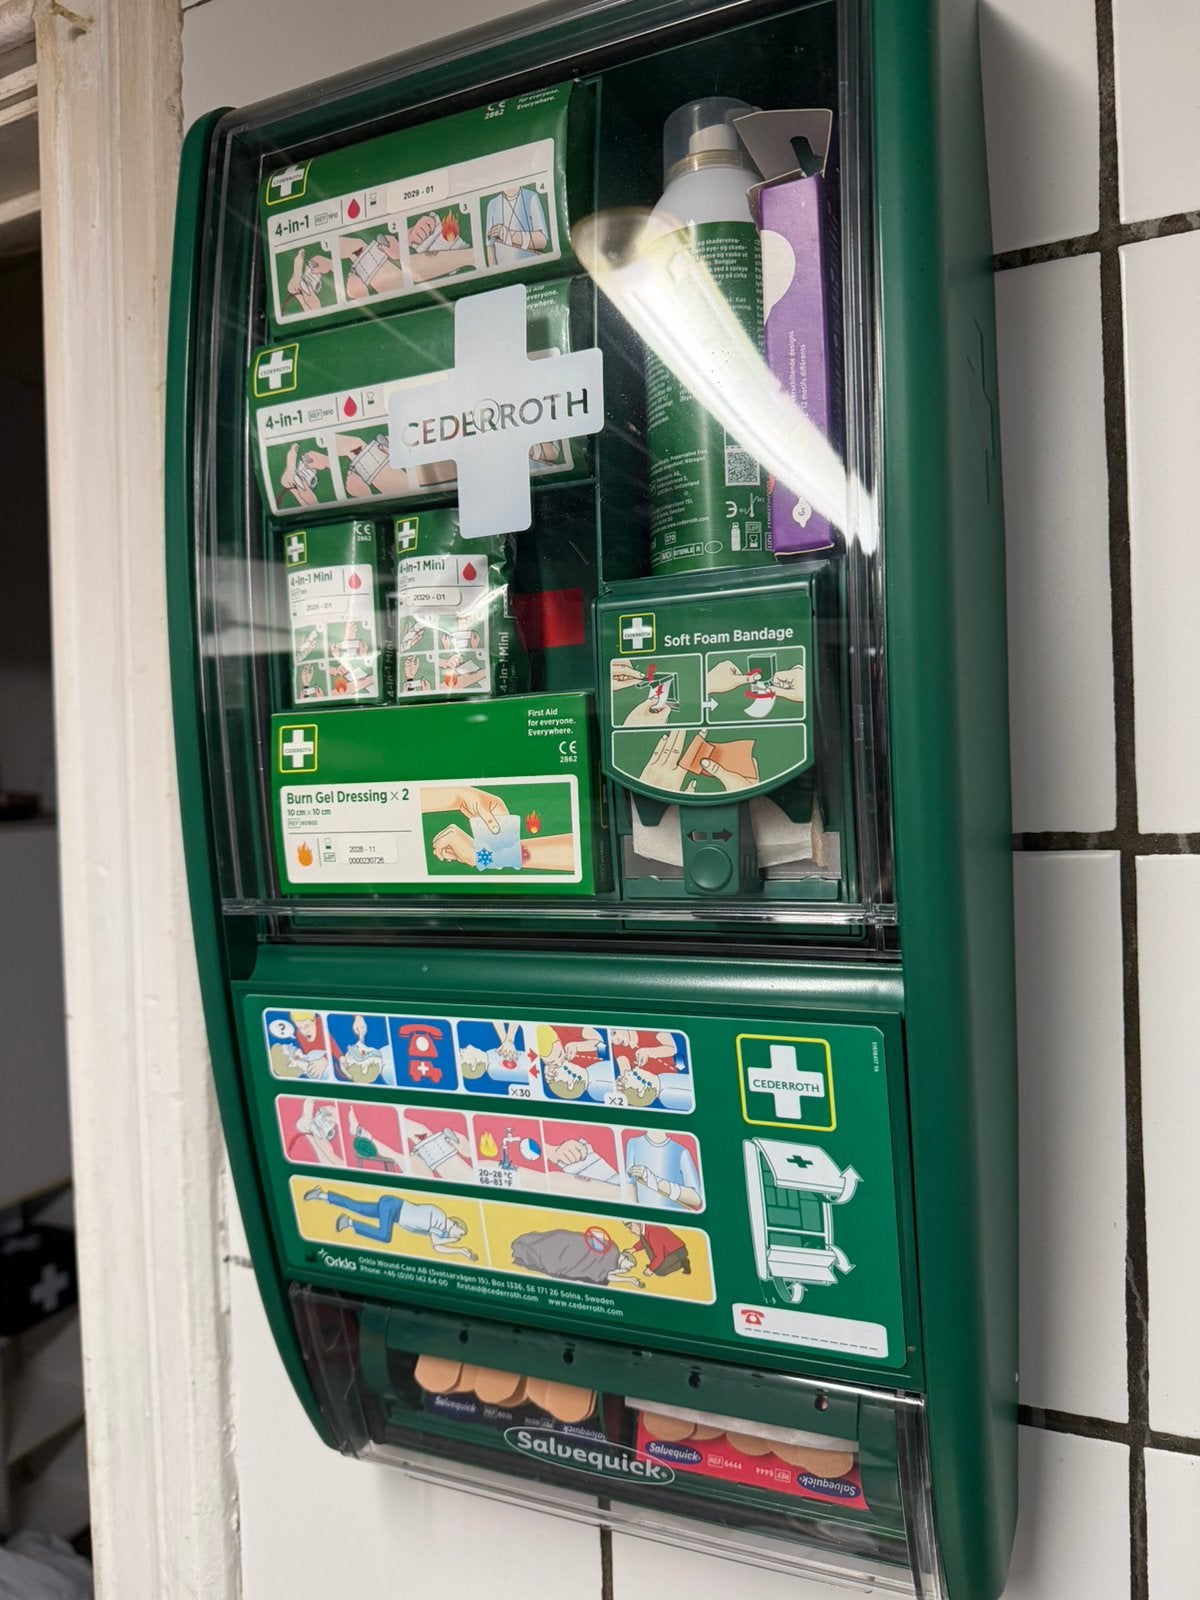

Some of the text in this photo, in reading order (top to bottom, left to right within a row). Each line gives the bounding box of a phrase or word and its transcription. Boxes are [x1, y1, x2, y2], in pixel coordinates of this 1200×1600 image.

[484, 109, 504, 120] 2862
[540, 182, 545, 191] 4
[403, 188, 420, 200] 2029
[463, 203, 468, 212] 3
[274, 215, 310, 236] 4-in-1
[260, 366, 291, 376] CEDERROTH
[266, 410, 303, 430] 4-in-1
[402, 388, 589, 448] CEDERROTH
[423, 559, 445, 570] Mini
[290, 570, 332, 586] 4-in-1 Mini
[500, 632, 509, 656] Mini
[664, 627, 794, 647] Soft Foam Bandage
[546, 708, 558, 716] Aid
[539, 717, 576, 727] everyone.
[528, 727, 573, 736] Everywhere.
[559, 741, 577, 754] CE
[287, 791, 312, 805] Burn
[315, 790, 334, 804] Gel
[337, 789, 387, 805] Dressing
[402, 788, 409, 800] 2
[753, 1079, 820, 1093] CEDERROTH
[479, 1169, 502, 1178] 20-28
[325, 1255, 357, 1271] Orkla
[358, 1256, 376, 1266] Orkla
[377, 1259, 399, 1270] Wound
[401, 1264, 416, 1272] Care
[491, 1279, 505, 1288] Box
[506, 1281, 525, 1291] 1336,
[537, 1286, 548, 1294] 171
[560, 1290, 583, 1301] Solna,
[584, 1294, 615, 1306] Sweden
[360, 1265, 382, 1275] Phone:
[415, 1275, 427, 1283] 142
[427, 1277, 437, 1285] 64
[456, 1282, 538, 1302] firstaid@cederroth.com
[548, 1298, 623, 1317] www.cederroth.com
[435, 1396, 476, 1413] Salvequick
[649, 1442, 698, 1461] Salvequick
[710, 1457, 742, 1470] REF 6444
[756, 1466, 790, 1480] 6444 REF
[802, 1476, 856, 1496] Salvequick
